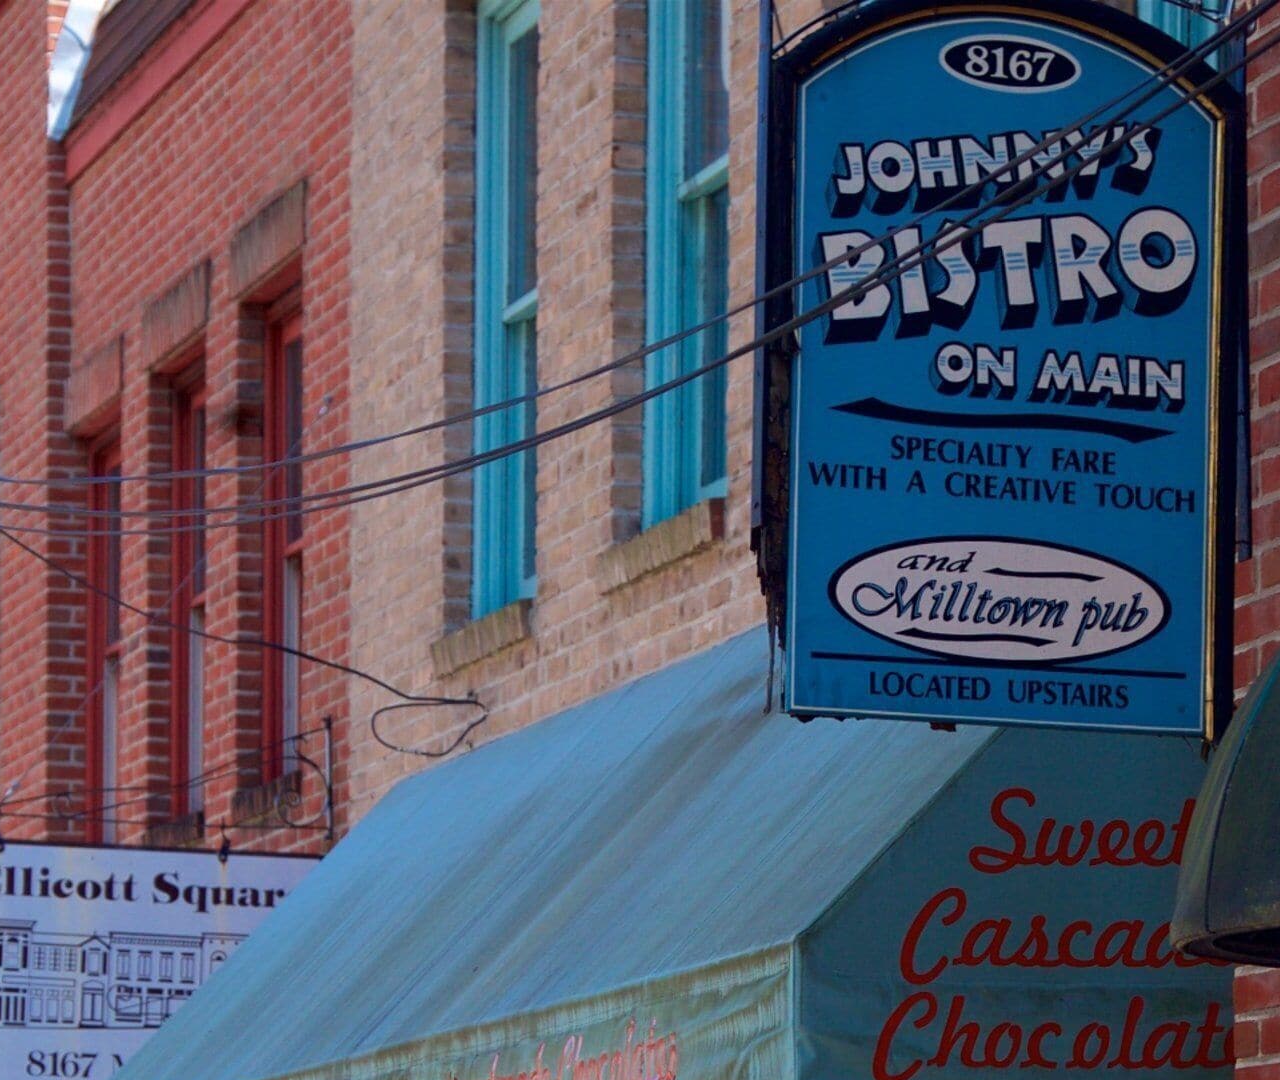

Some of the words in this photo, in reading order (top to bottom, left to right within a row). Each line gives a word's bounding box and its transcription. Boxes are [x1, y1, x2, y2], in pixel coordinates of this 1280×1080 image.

[964, 45, 1054, 83] 8167
[832, 122, 1160, 212] JOHNNY'S
[819, 207, 1199, 338] BISTRO
[933, 342, 1017, 393] ON
[1036, 349, 1186, 406] MAIN
[890, 435, 1032, 470] SPECIALTY
[1051, 448, 1117, 476] FARE
[809, 461, 888, 492] WITH
[906, 470, 927, 495] A
[945, 472, 1076, 505] CREATIVE
[1094, 483, 1196, 514] TOUCH
[896, 549, 977, 575] and
[851, 577, 1070, 629] Milltown
[1074, 590, 1151, 647] pub
[868, 669, 992, 702] LOCATED
[1007, 677, 1130, 710] UPSTAIRS
[967, 787, 1198, 875] Sweet
[152, 871, 286, 914] Squar
[25, 1051, 99, 1080] 8167
